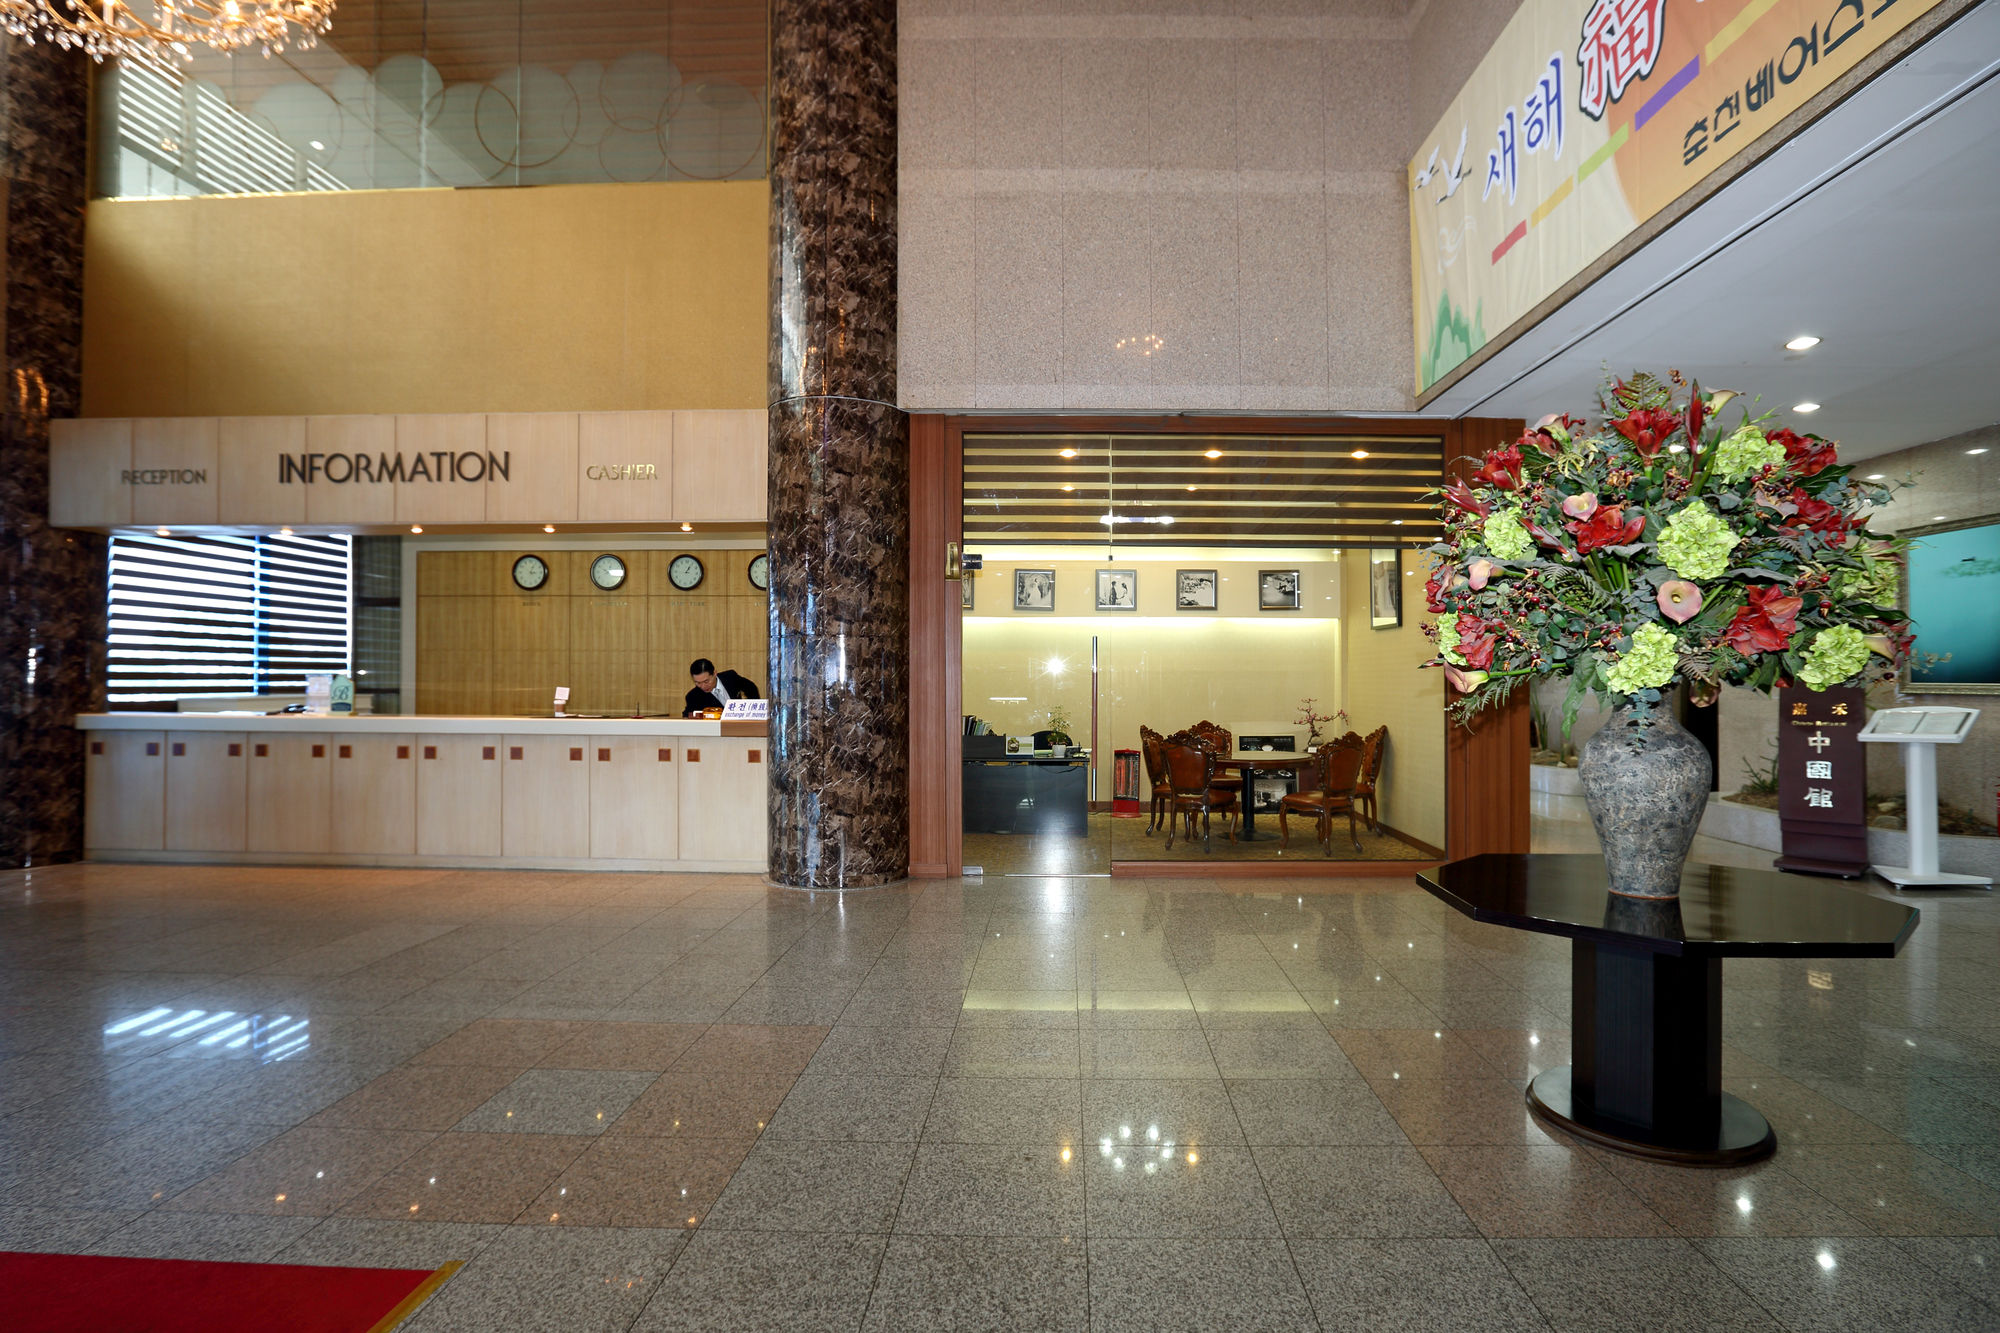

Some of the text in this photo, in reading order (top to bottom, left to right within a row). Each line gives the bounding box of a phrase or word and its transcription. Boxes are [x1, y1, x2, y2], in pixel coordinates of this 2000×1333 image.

[1683, 0, 1898, 166] 춘천베어스
[1482, 52, 1563, 205] 새해
[121, 469, 207, 485] RECEPTION
[279, 451, 510, 484] INFORMATION
[586, 463, 658, 481] CASHIER
[1803, 731, 1833, 808] 中國館
